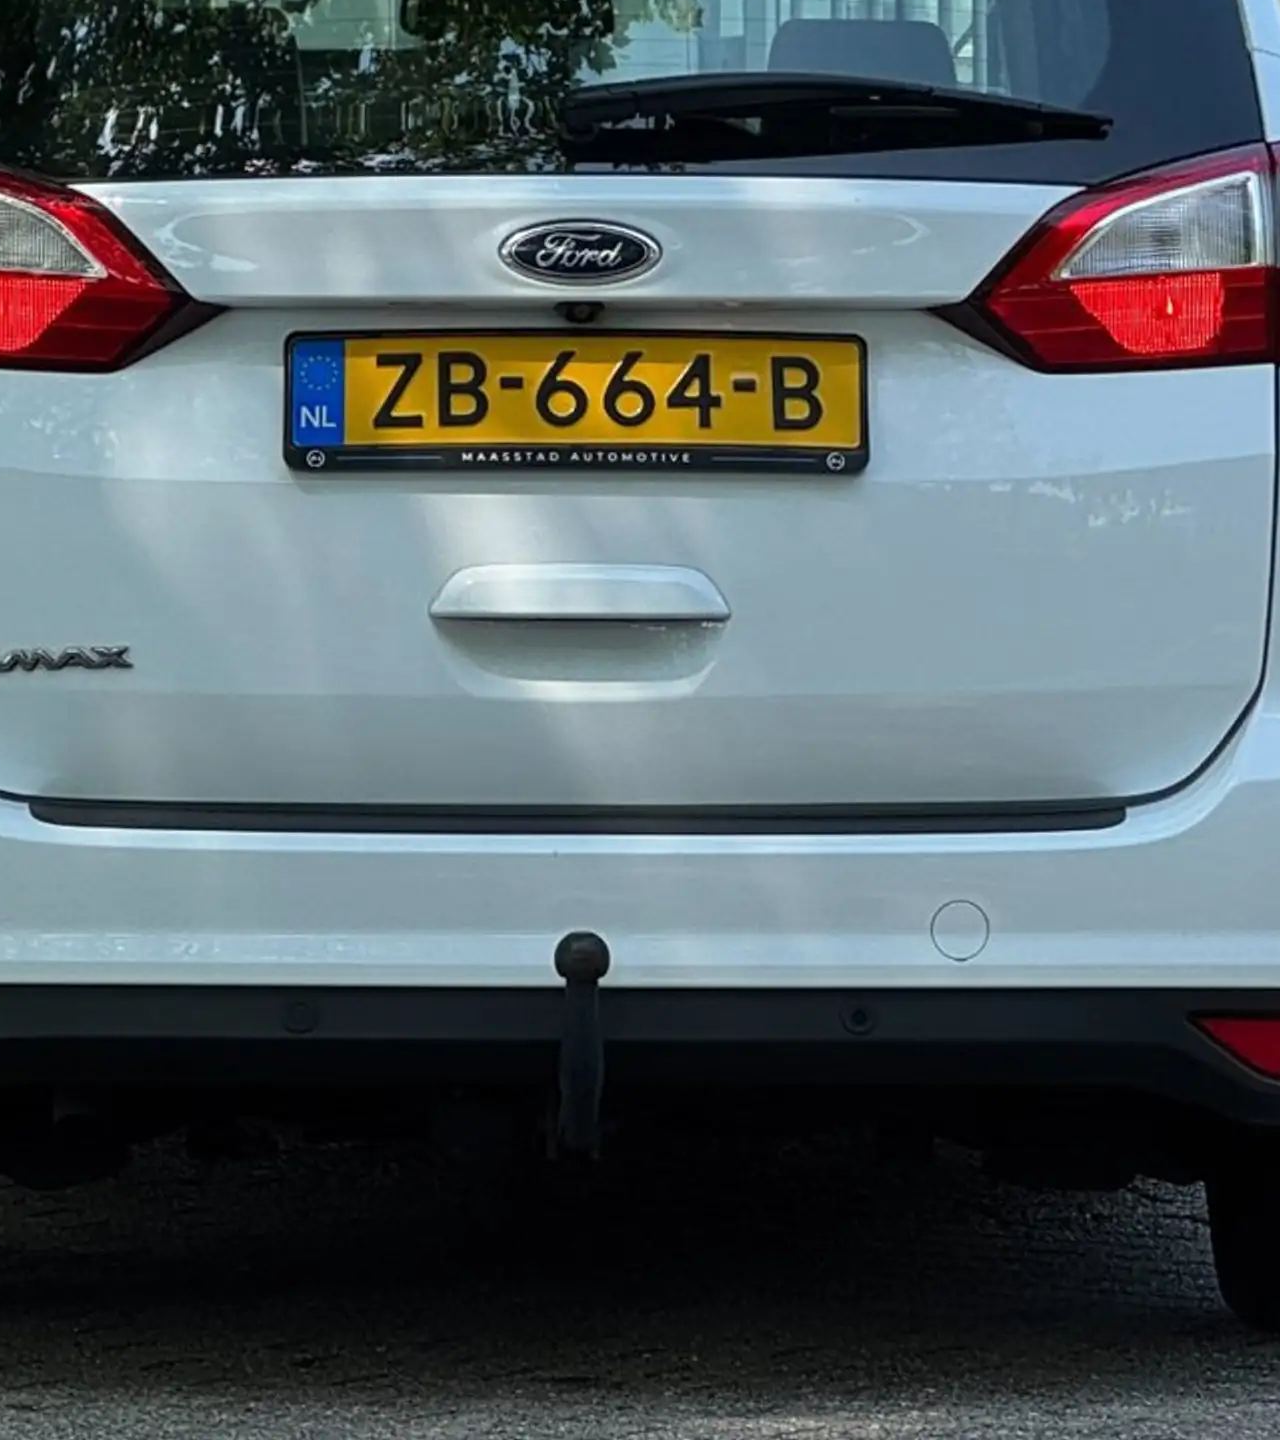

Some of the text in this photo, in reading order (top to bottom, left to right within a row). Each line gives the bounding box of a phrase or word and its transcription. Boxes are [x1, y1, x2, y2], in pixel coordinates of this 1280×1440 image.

[535, 231, 624, 267] Ford
[372, 350, 824, 432] ZB-664-B
[300, 404, 337, 429] NL
[462, 451, 691, 465] MAASSTAD AUTOMOTIVE
